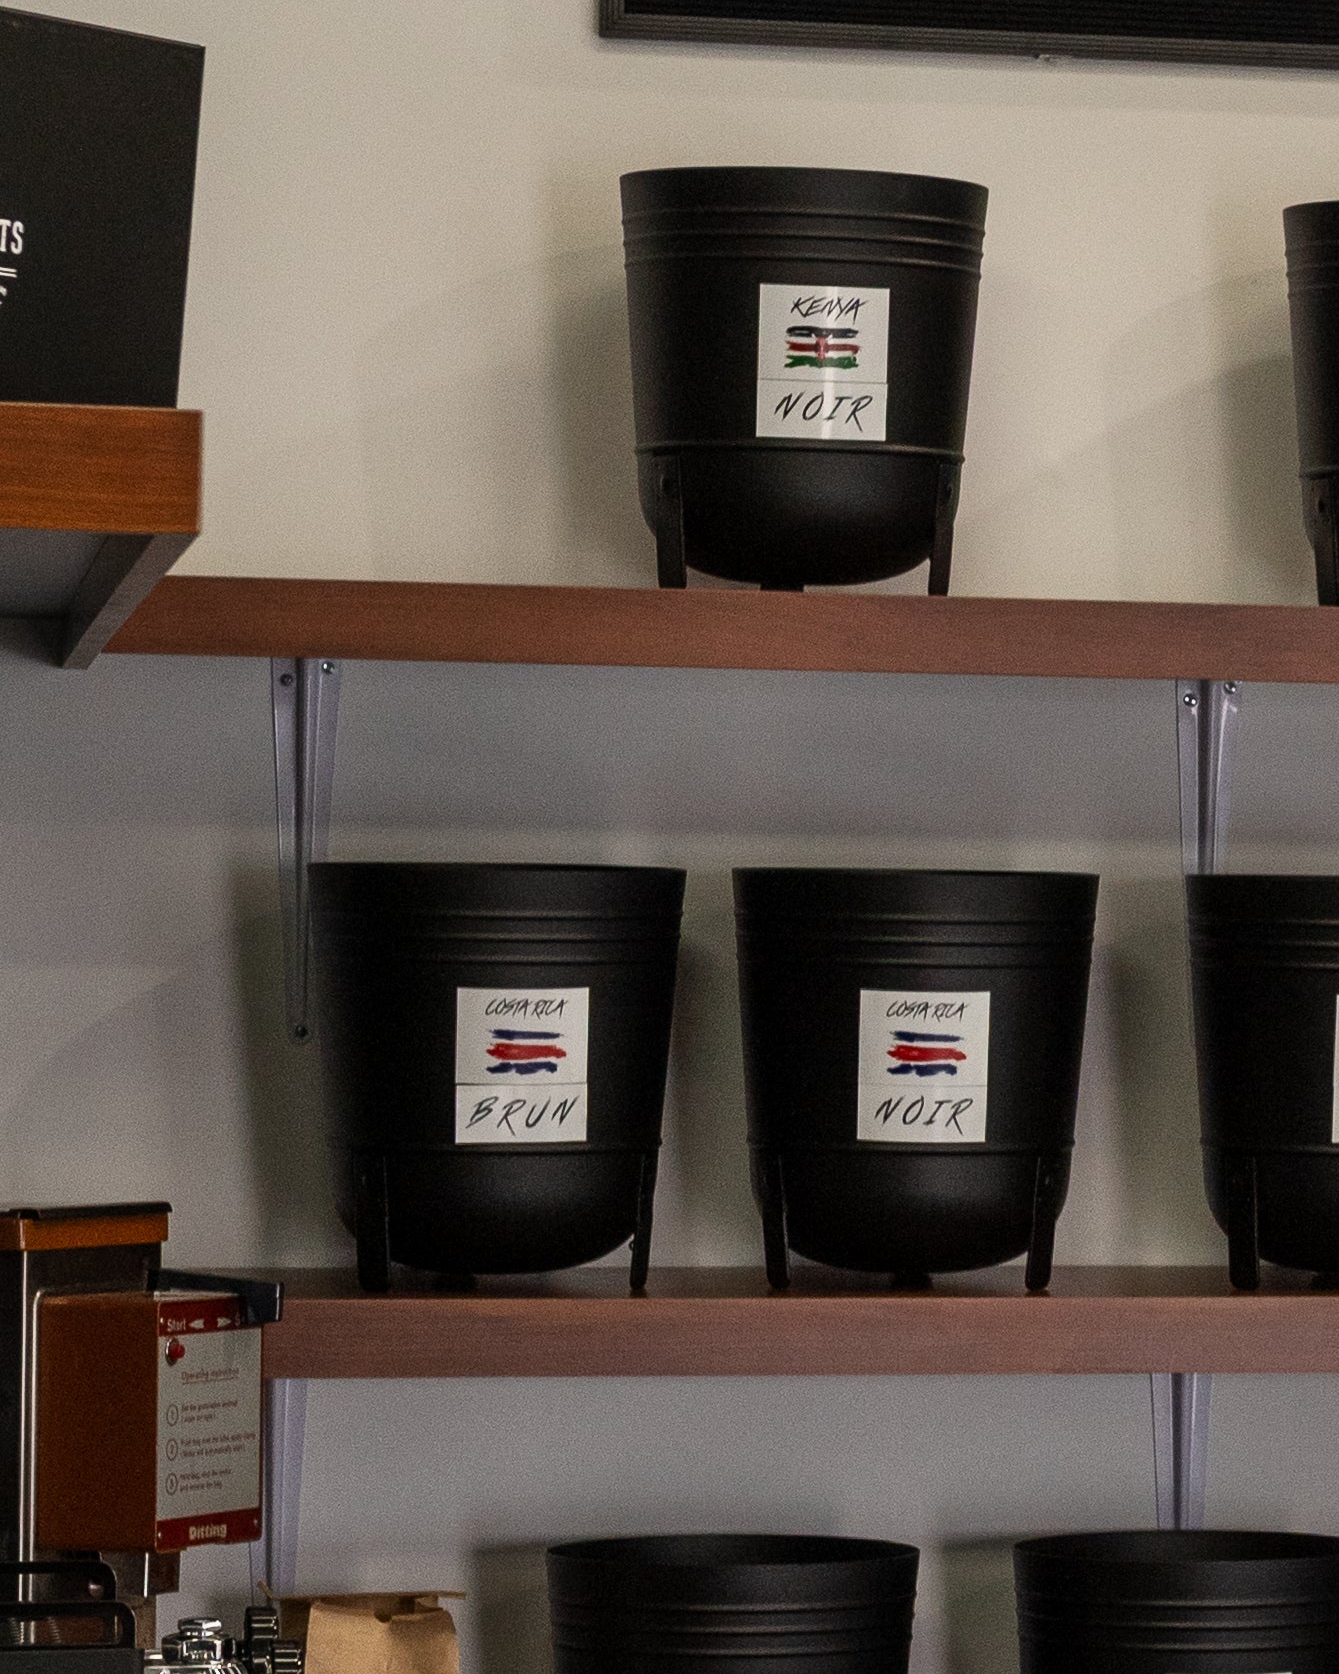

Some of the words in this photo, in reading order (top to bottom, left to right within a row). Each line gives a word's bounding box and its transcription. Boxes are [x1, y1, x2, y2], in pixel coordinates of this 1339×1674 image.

[790, 295, 868, 325] KENYA
[774, 391, 873, 433] NOIR
[485, 998, 530, 1019] COSTA
[531, 998, 568, 1019] RICA
[886, 999, 930, 1020] COSTA
[931, 1001, 968, 1022] RICA
[465, 1094, 581, 1137] BRUN
[874, 1095, 974, 1136] NOIR
[166, 1318, 186, 1332] Start
